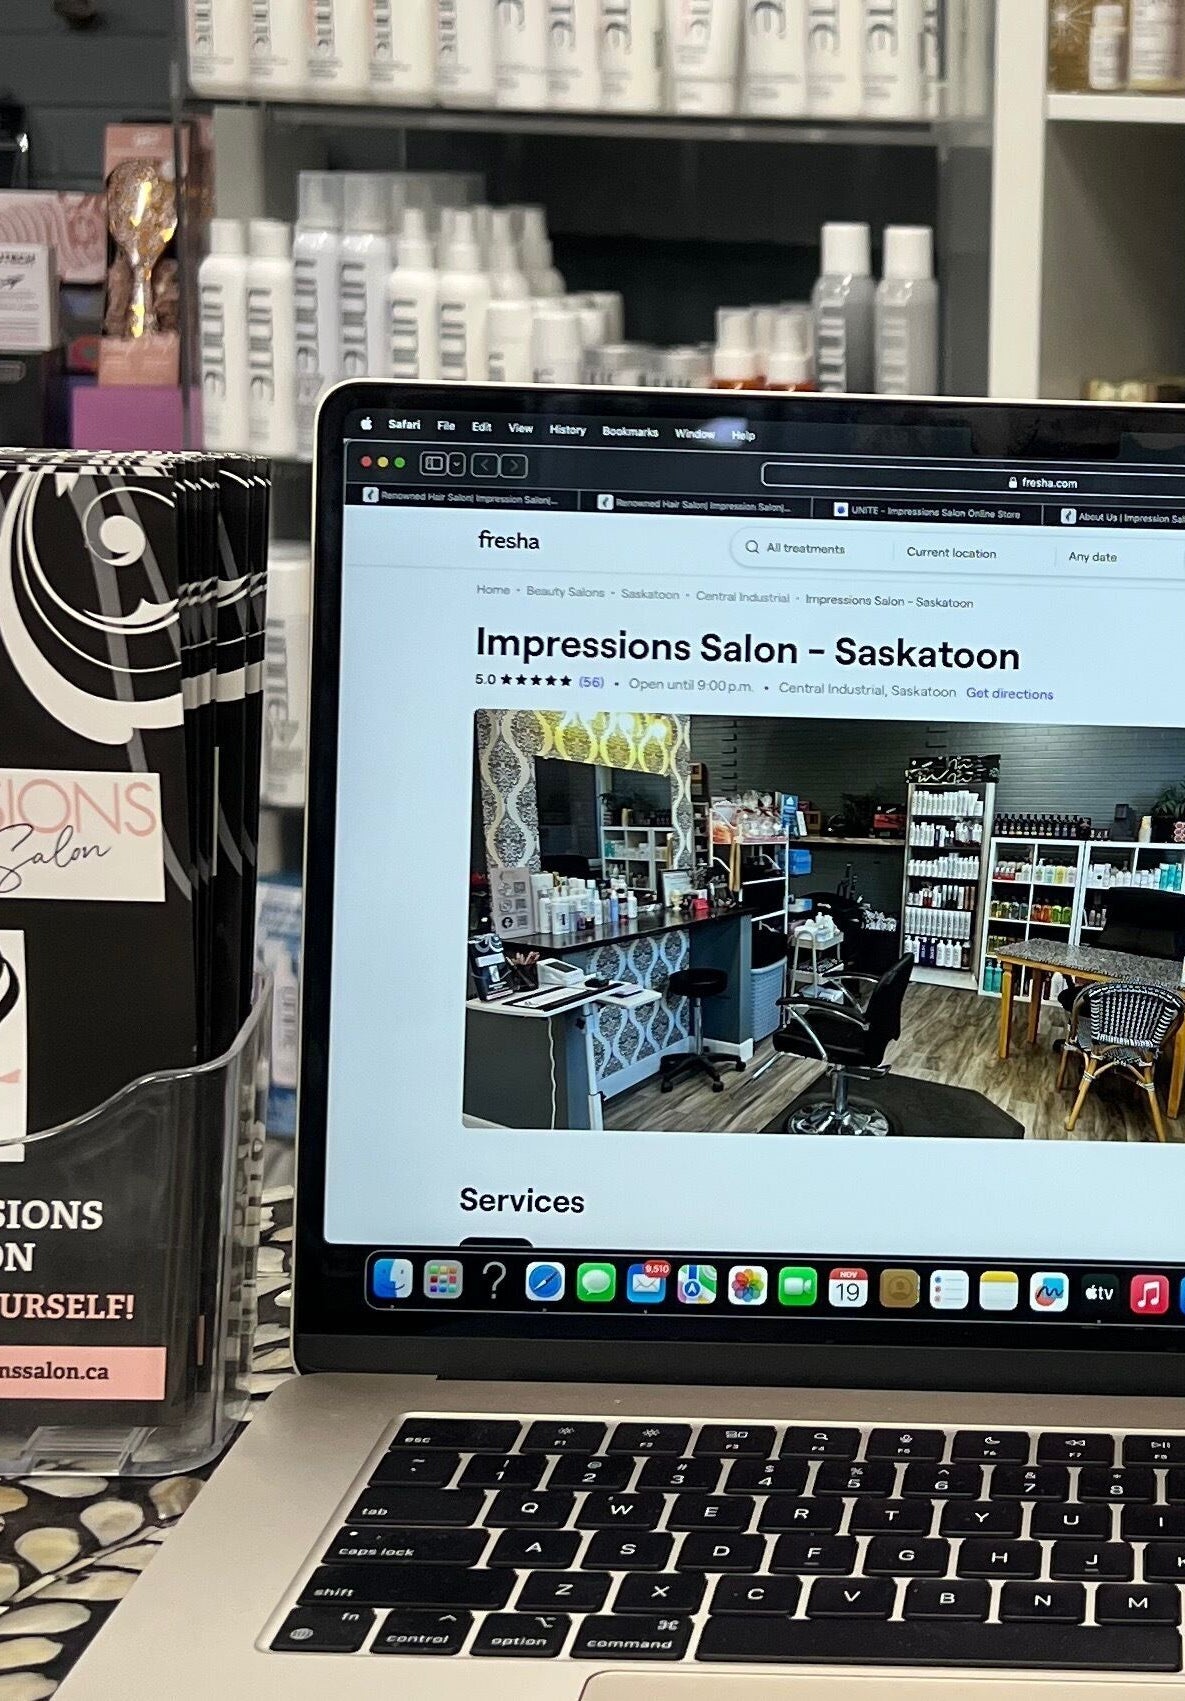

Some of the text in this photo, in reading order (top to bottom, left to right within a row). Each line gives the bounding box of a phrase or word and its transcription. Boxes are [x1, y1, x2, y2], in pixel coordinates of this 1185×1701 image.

[388, 419, 755, 442] Safari File Edit View History Bookmarks Window Help
[1022, 477, 1078, 490] fresha.com
[381, 489, 424, 500] Renowned
[427, 491, 445, 501] Hair
[616, 498, 658, 509] Renowned
[661, 500, 679, 509] Hair
[851, 505, 1021, 520] UNITE Impressions Salon Online Store
[1079, 511, 1102, 522] About
[1104, 512, 1118, 522] Us
[1124, 513, 1168, 525] Impression
[478, 530, 540, 550] fresha
[766, 542, 845, 554] All treatments
[906, 546, 997, 560] Current location
[1068, 551, 1117, 564] Any date
[476, 585, 974, 608] Home Beauty Salons Saskatoon Central Industrial Impressions Salon Saskatoon
[477, 628, 1021, 671] Impressions Salon Saskatoon
[474, 673, 496, 685] 5.0
[578, 675, 605, 689] (56)
[628, 679, 664, 692] Open
[667, 678, 695, 690] until
[779, 683, 824, 694] Central
[827, 684, 888, 697] Industrial,
[891, 686, 957, 698] Saskatoon
[967, 687, 990, 698] Get
[993, 687, 1055, 700] directions
[0, 778, 157, 837] IONS
[460, 1187, 585, 1215] Services
[835, 1283, 860, 1306] 19
[495, 1471, 506, 1481] 1
[582, 1472, 597, 1483] 2
[669, 1475, 684, 1485] 3
[758, 1476, 773, 1487] 4
[934, 1481, 949, 1491] 6
[1023, 1483, 1036, 1493] 7
[362, 1507, 388, 1517] tab
[521, 1503, 539, 1515] Q
[610, 1504, 633, 1515] W
[704, 1506, 719, 1518] E
[794, 1508, 810, 1519] R
[885, 1510, 900, 1521] T
[974, 1512, 990, 1523] Y
[1063, 1515, 1080, 1526] U
[338, 1547, 415, 1559] caps lock
[525, 1541, 543, 1554] A
[619, 1543, 637, 1555] S
[712, 1545, 730, 1557] D
[807, 1547, 822, 1559] F
[898, 1550, 915, 1562] G
[991, 1552, 1008, 1564] H
[1085, 1553, 1098, 1566] J
[313, 1587, 354, 1598] shift
[555, 1584, 573, 1596] Z
[651, 1585, 670, 1597] X
[747, 1588, 764, 1601] C
[843, 1590, 860, 1603] V
[939, 1592, 955, 1605] B
[1034, 1594, 1052, 1606] N
[1128, 1596, 1148, 1609] M
[341, 1611, 360, 1622] fn
[386, 1633, 450, 1645] control
[491, 1636, 547, 1648] option
[586, 1638, 672, 1650] command
